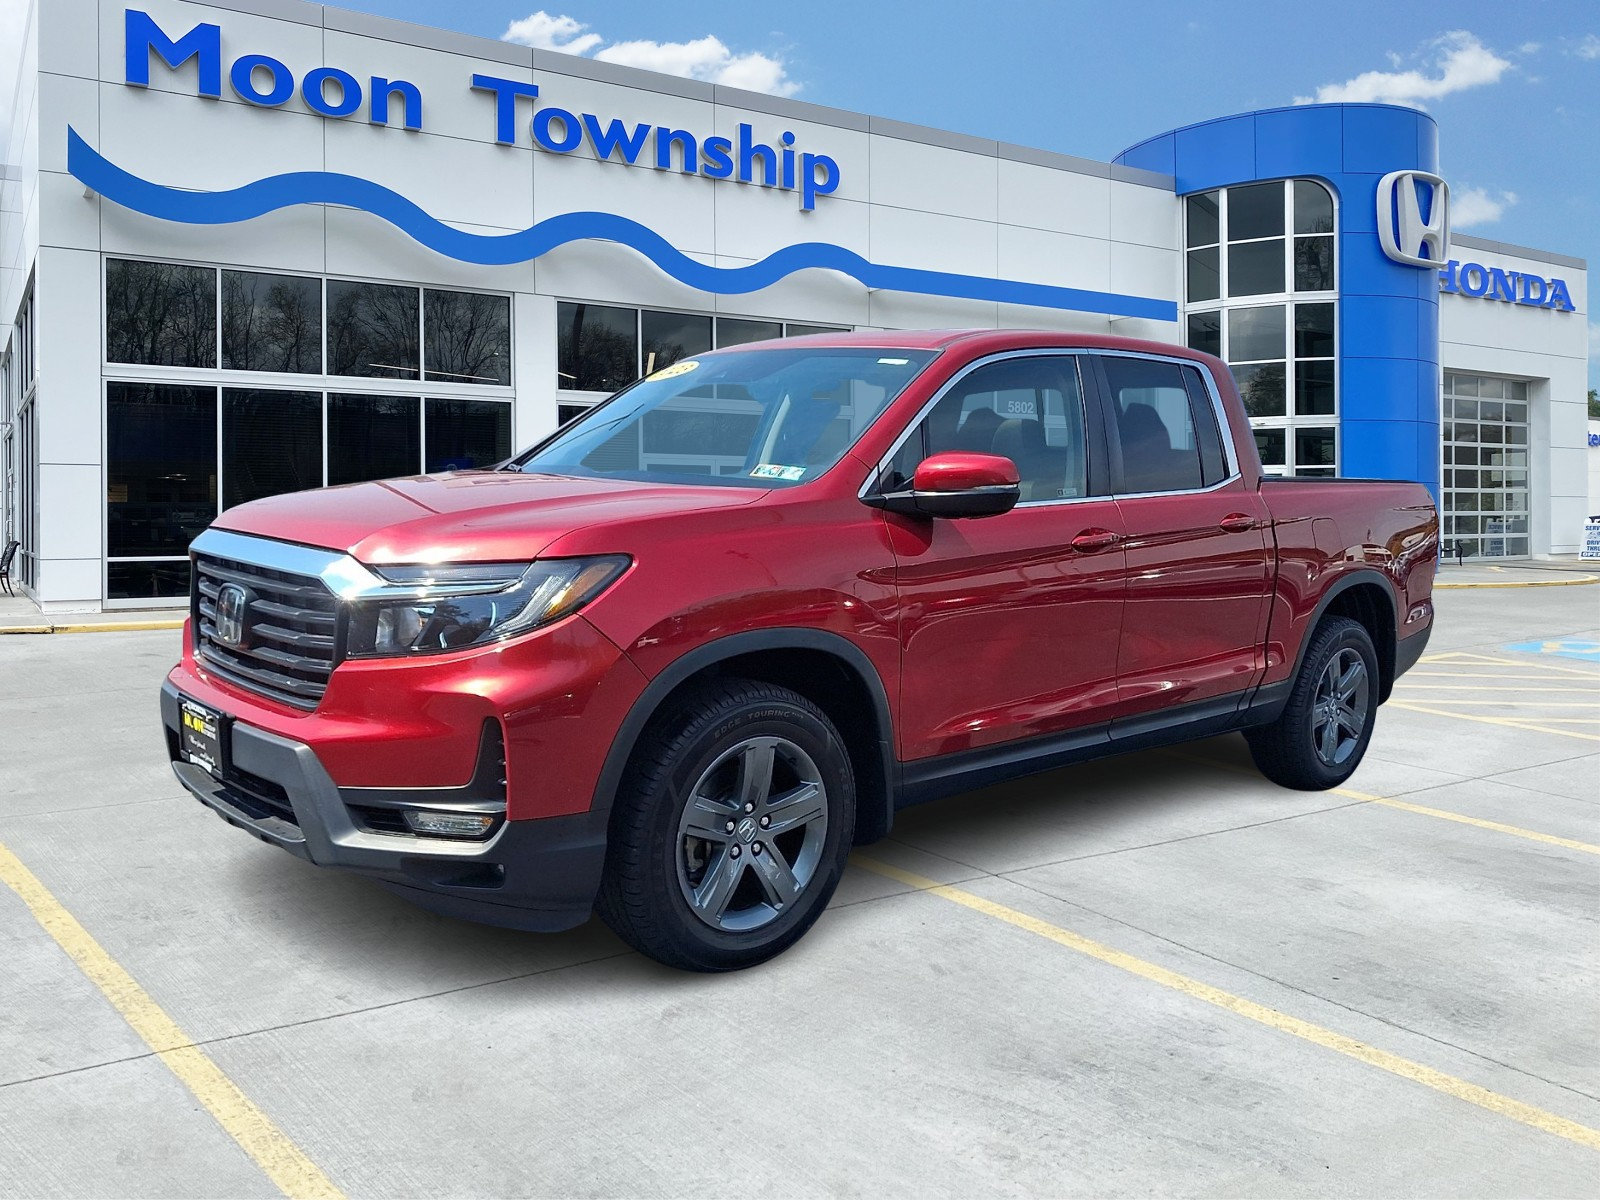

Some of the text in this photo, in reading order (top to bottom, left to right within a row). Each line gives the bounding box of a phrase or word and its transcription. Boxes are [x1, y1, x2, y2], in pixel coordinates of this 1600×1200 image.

[125, 8, 841, 213] Moon Township
[1439, 259, 1576, 312] HONDA
[1008, 401, 1034, 414] 5802
[747, 709, 791, 720] TOURING
